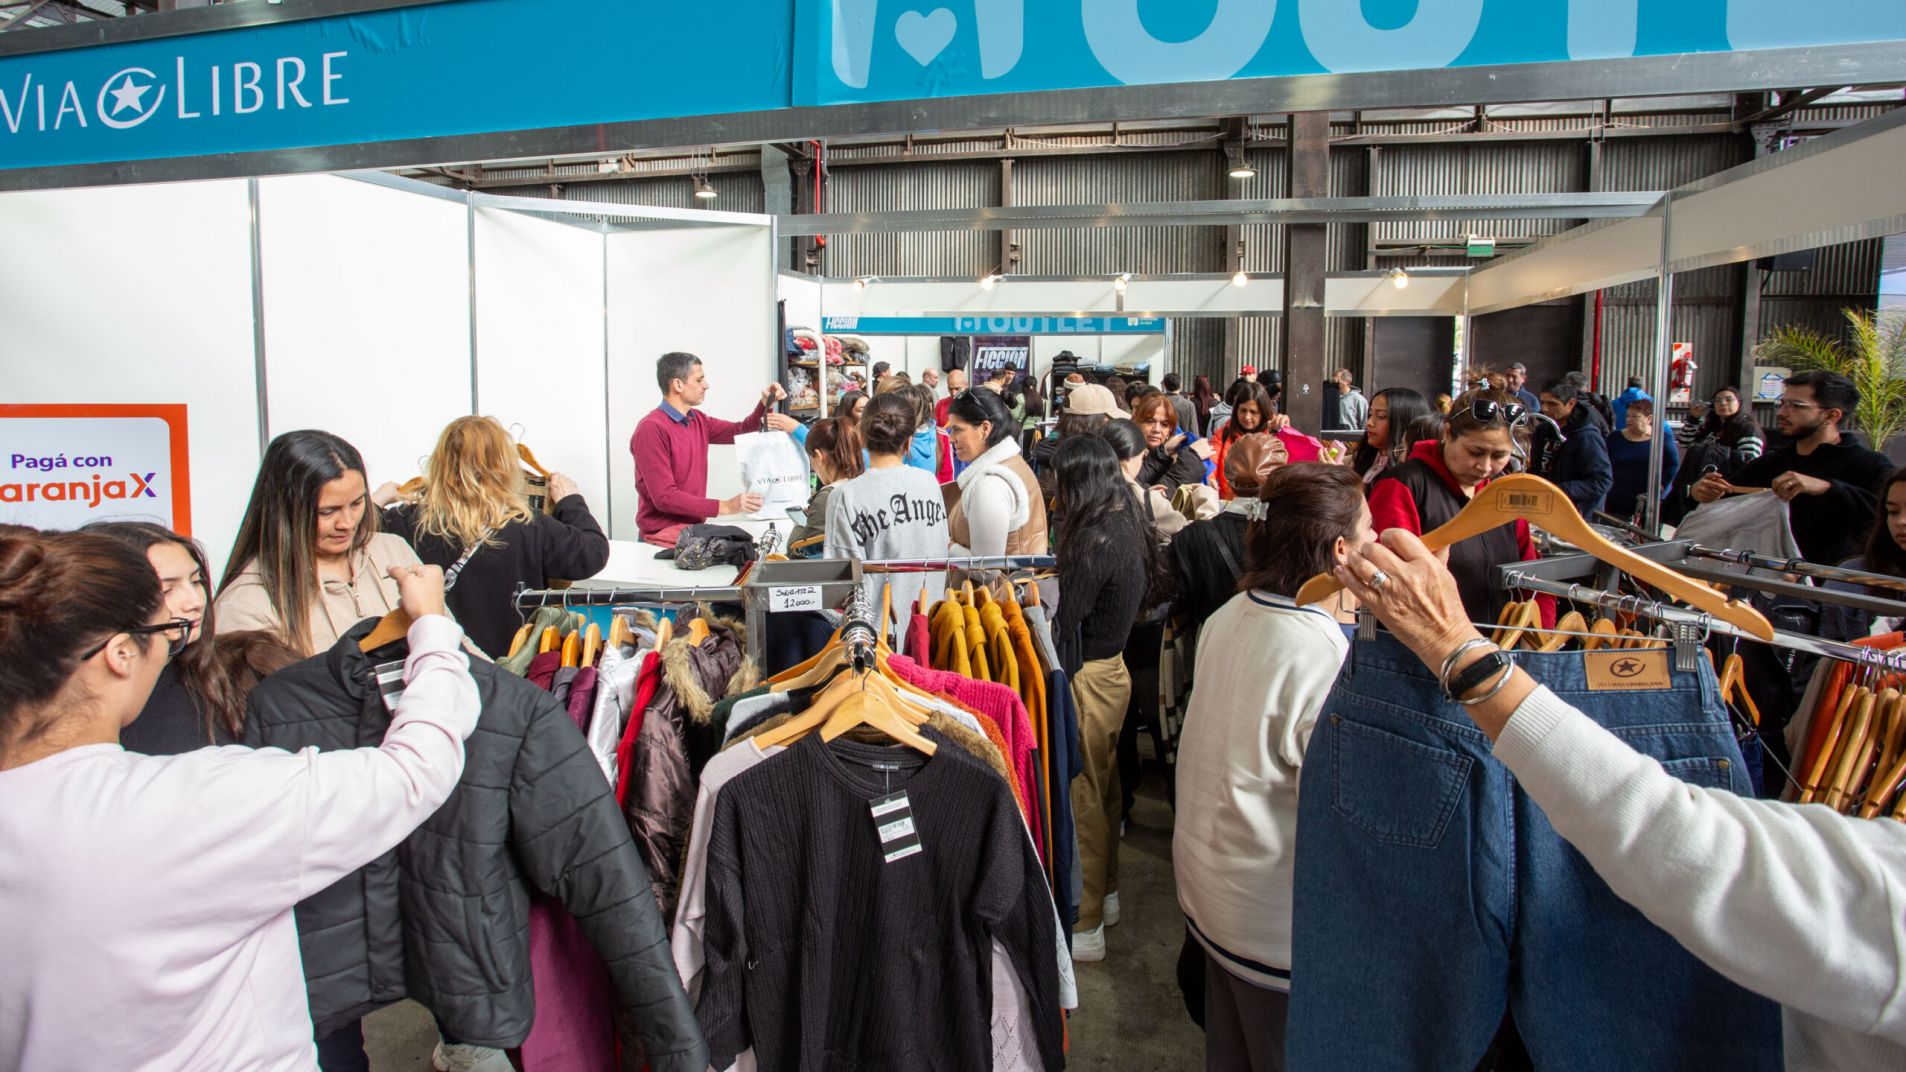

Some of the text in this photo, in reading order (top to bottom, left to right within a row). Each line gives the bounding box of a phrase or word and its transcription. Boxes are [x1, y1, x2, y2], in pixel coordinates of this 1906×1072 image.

[0, 51, 350, 133] VIA LIBRE
[11, 453, 113, 472] Pagá con
[851, 492, 948, 547] The Ange
